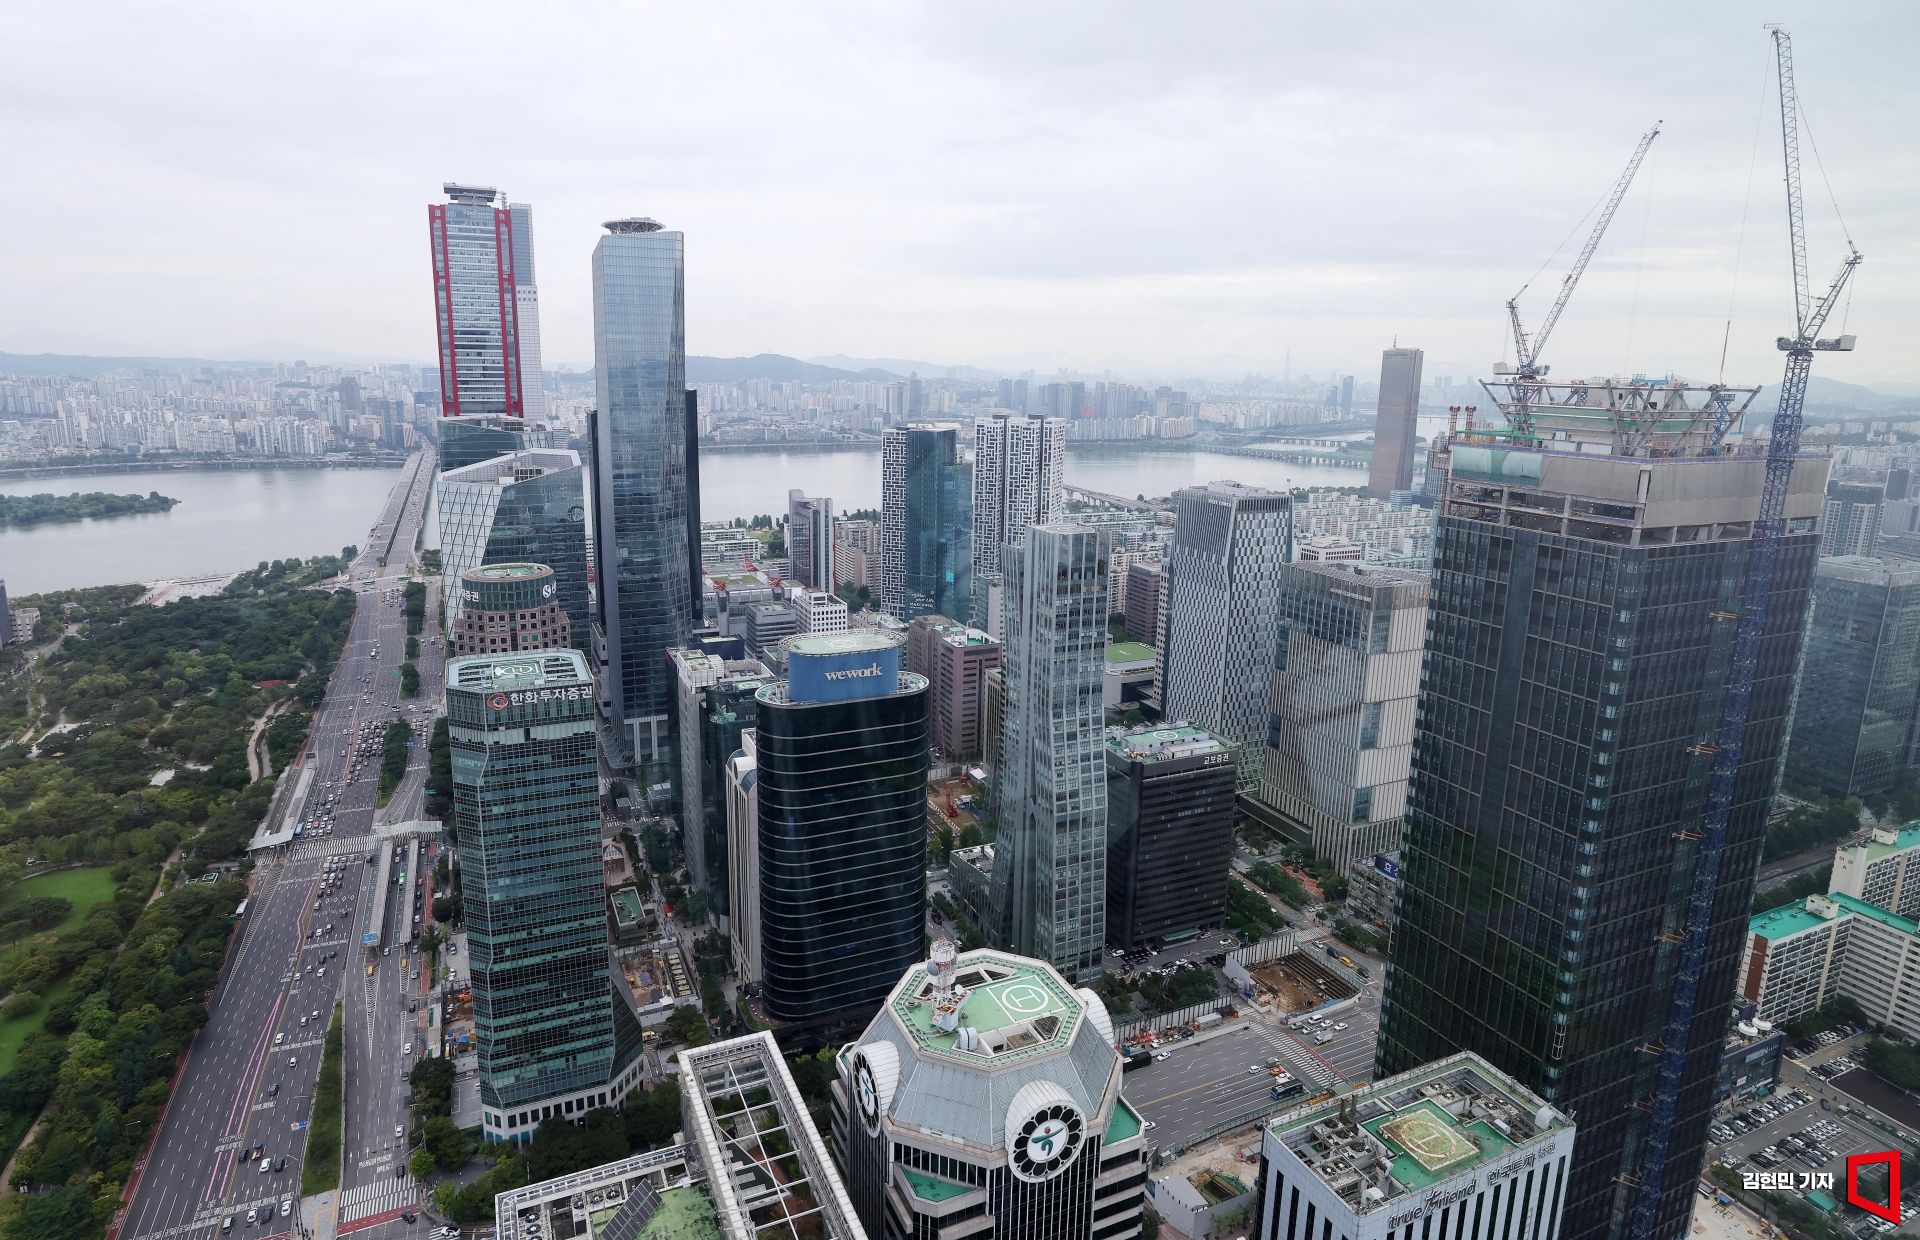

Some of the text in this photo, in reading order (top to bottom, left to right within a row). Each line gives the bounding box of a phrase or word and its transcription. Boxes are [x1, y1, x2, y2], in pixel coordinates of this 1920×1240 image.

[824, 662, 884, 681] wework
[510, 686, 593, 706] 한화투자증권
[1203, 753, 1229, 765] 교보증권
